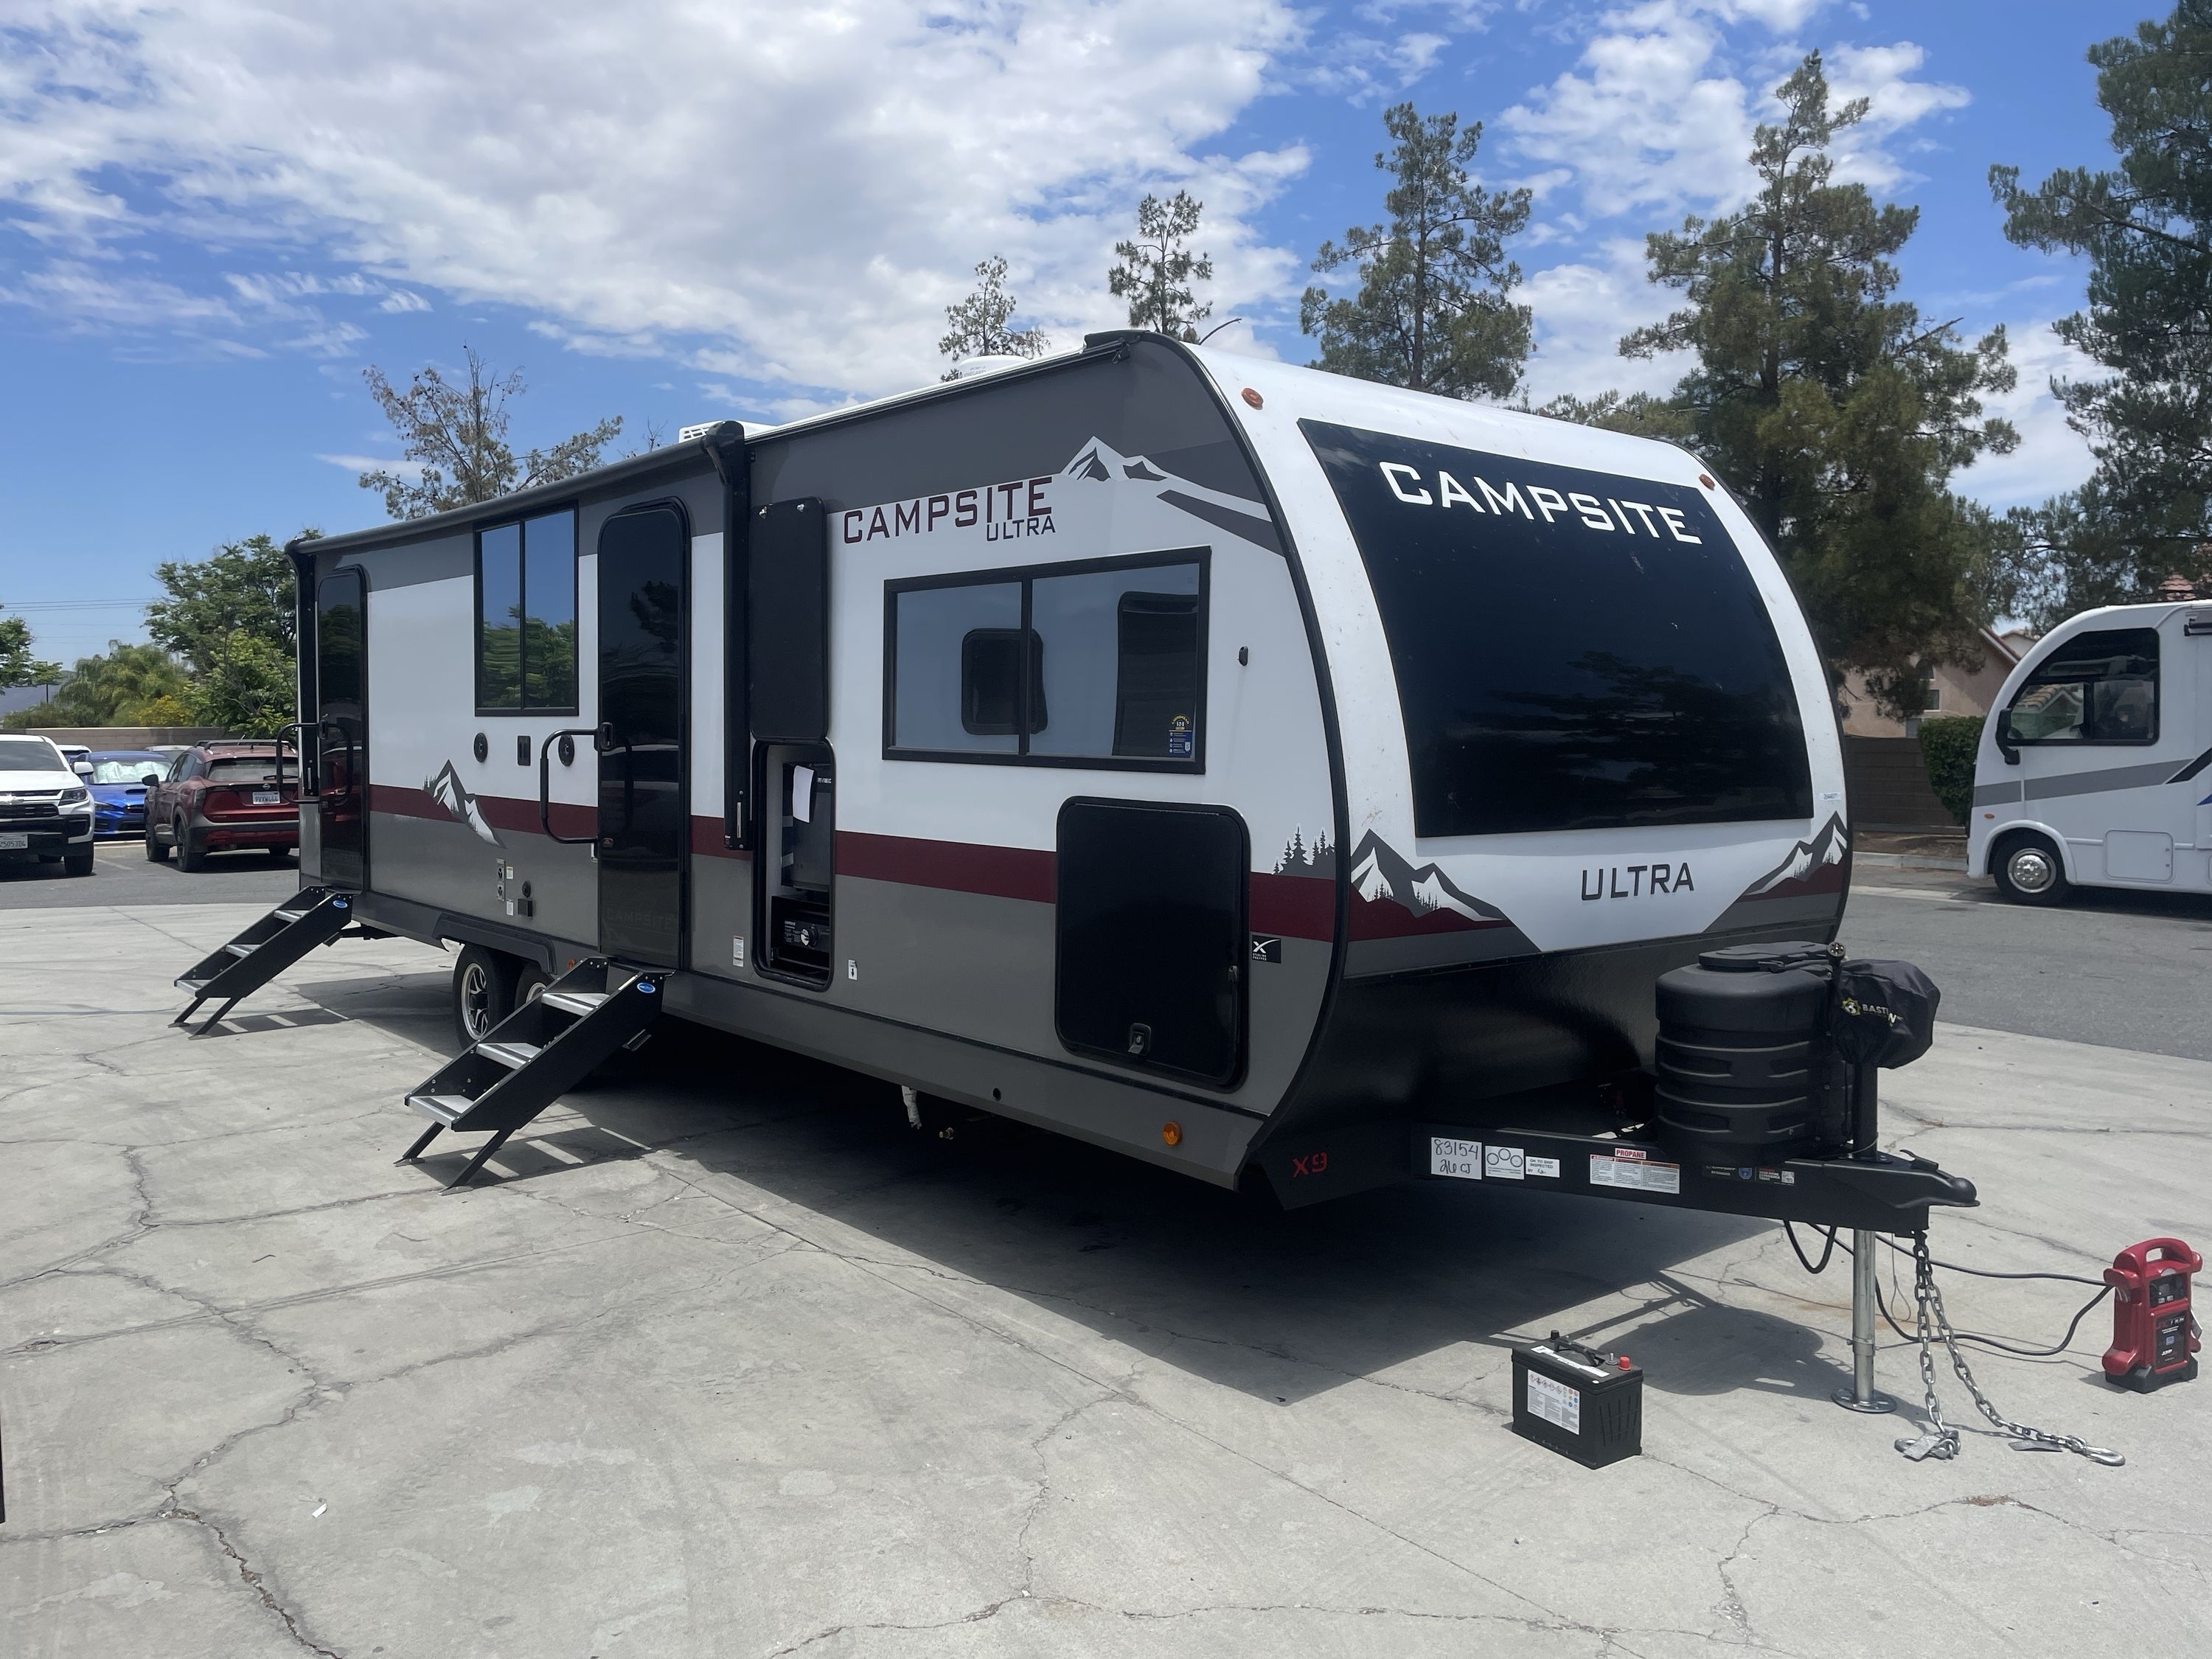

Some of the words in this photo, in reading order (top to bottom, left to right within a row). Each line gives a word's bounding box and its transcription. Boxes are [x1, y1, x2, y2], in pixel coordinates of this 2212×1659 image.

[843, 476, 1053, 544] CAMPSITE
[1379, 461, 1703, 545] CAMPSITE
[985, 515, 1057, 542] ULTRA
[1581, 862, 1694, 901] ULTRA
[1433, 1138, 1478, 1160] 83154
[1616, 1150, 1645, 1158] PROPANE
[1293, 1152, 1328, 1178] X9
